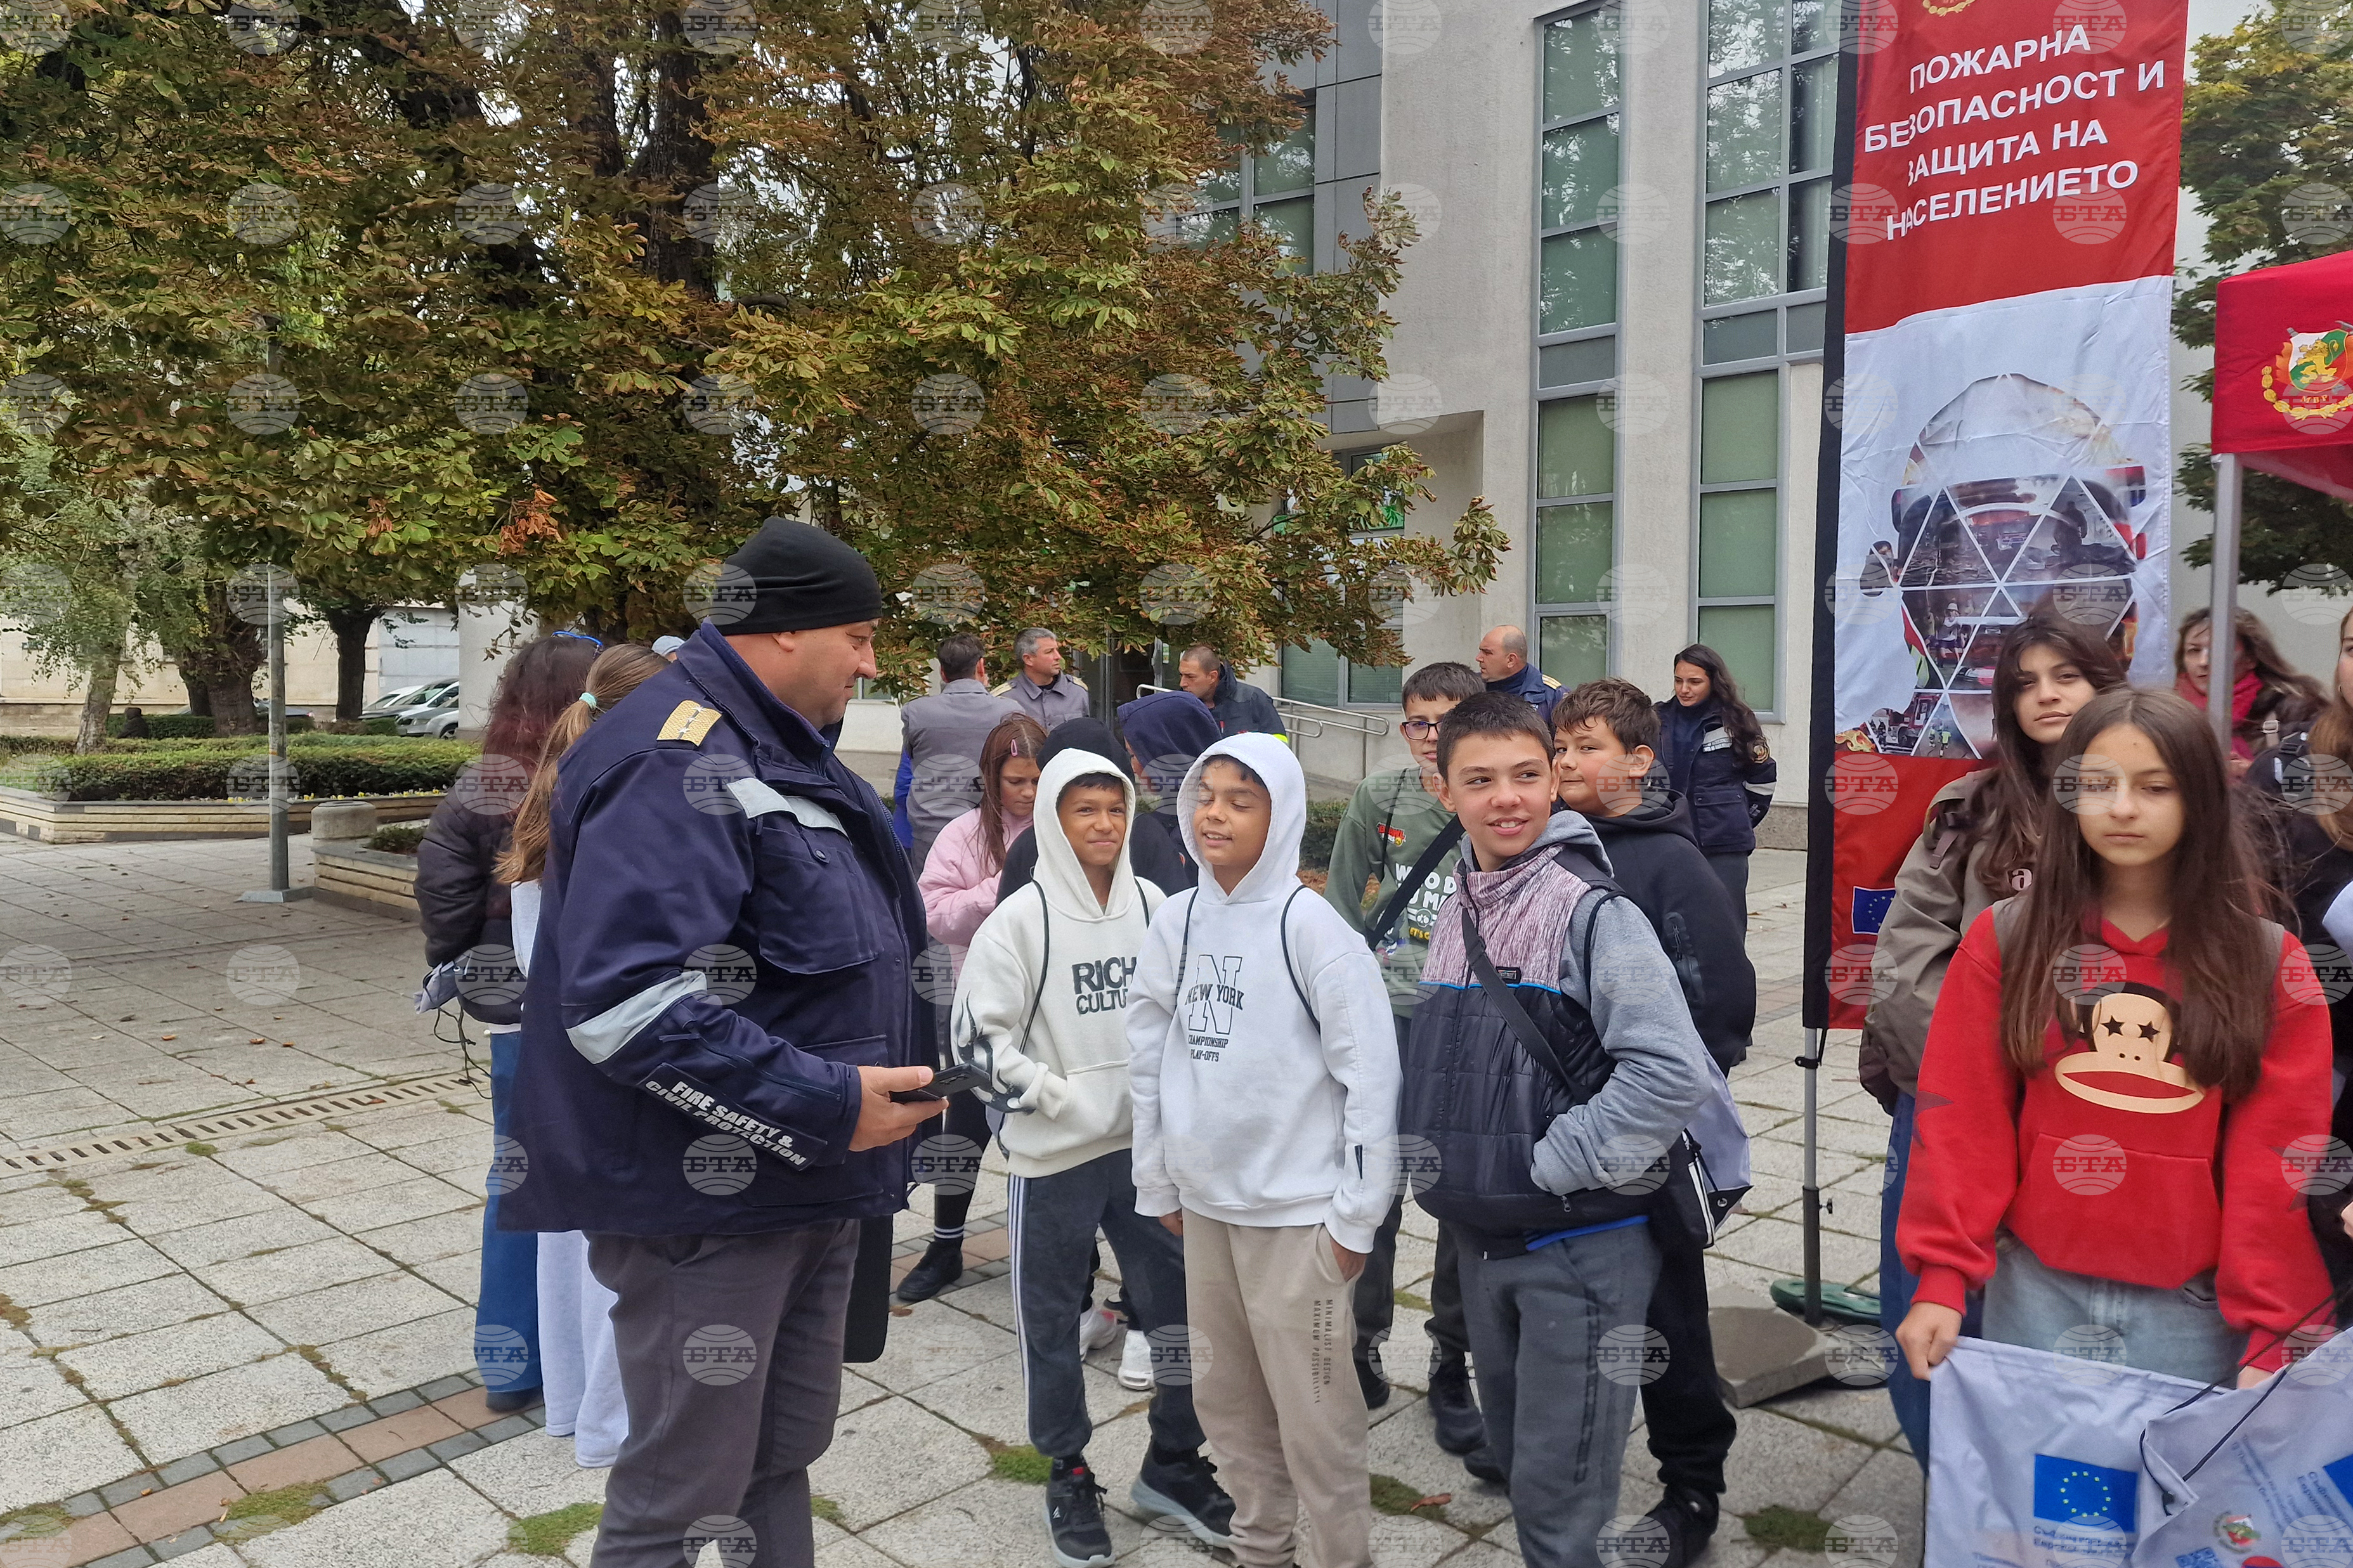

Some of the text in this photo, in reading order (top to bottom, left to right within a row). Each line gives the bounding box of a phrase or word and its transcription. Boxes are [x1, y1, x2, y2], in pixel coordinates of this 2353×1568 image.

[1910, 24, 2091, 94] ПОЖАРНА
[1865, 60, 2164, 152] БЕЗОПАСНОСТ И
[1908, 119, 2108, 187] ЗАЩИТА НА
[1887, 160, 2139, 241] НАСЕЛЕНИЕТО
[1072, 957, 1137, 994] RICH
[1076, 988, 1128, 1015] CULTU
[1184, 983, 1244, 1011] NEW YORK
[1190, 1049, 1220, 1063] PLAY-OFFS
[645, 1080, 807, 1165] CIVIL PROTECTION
[671, 1081, 793, 1148] FIRE SAFETY &
